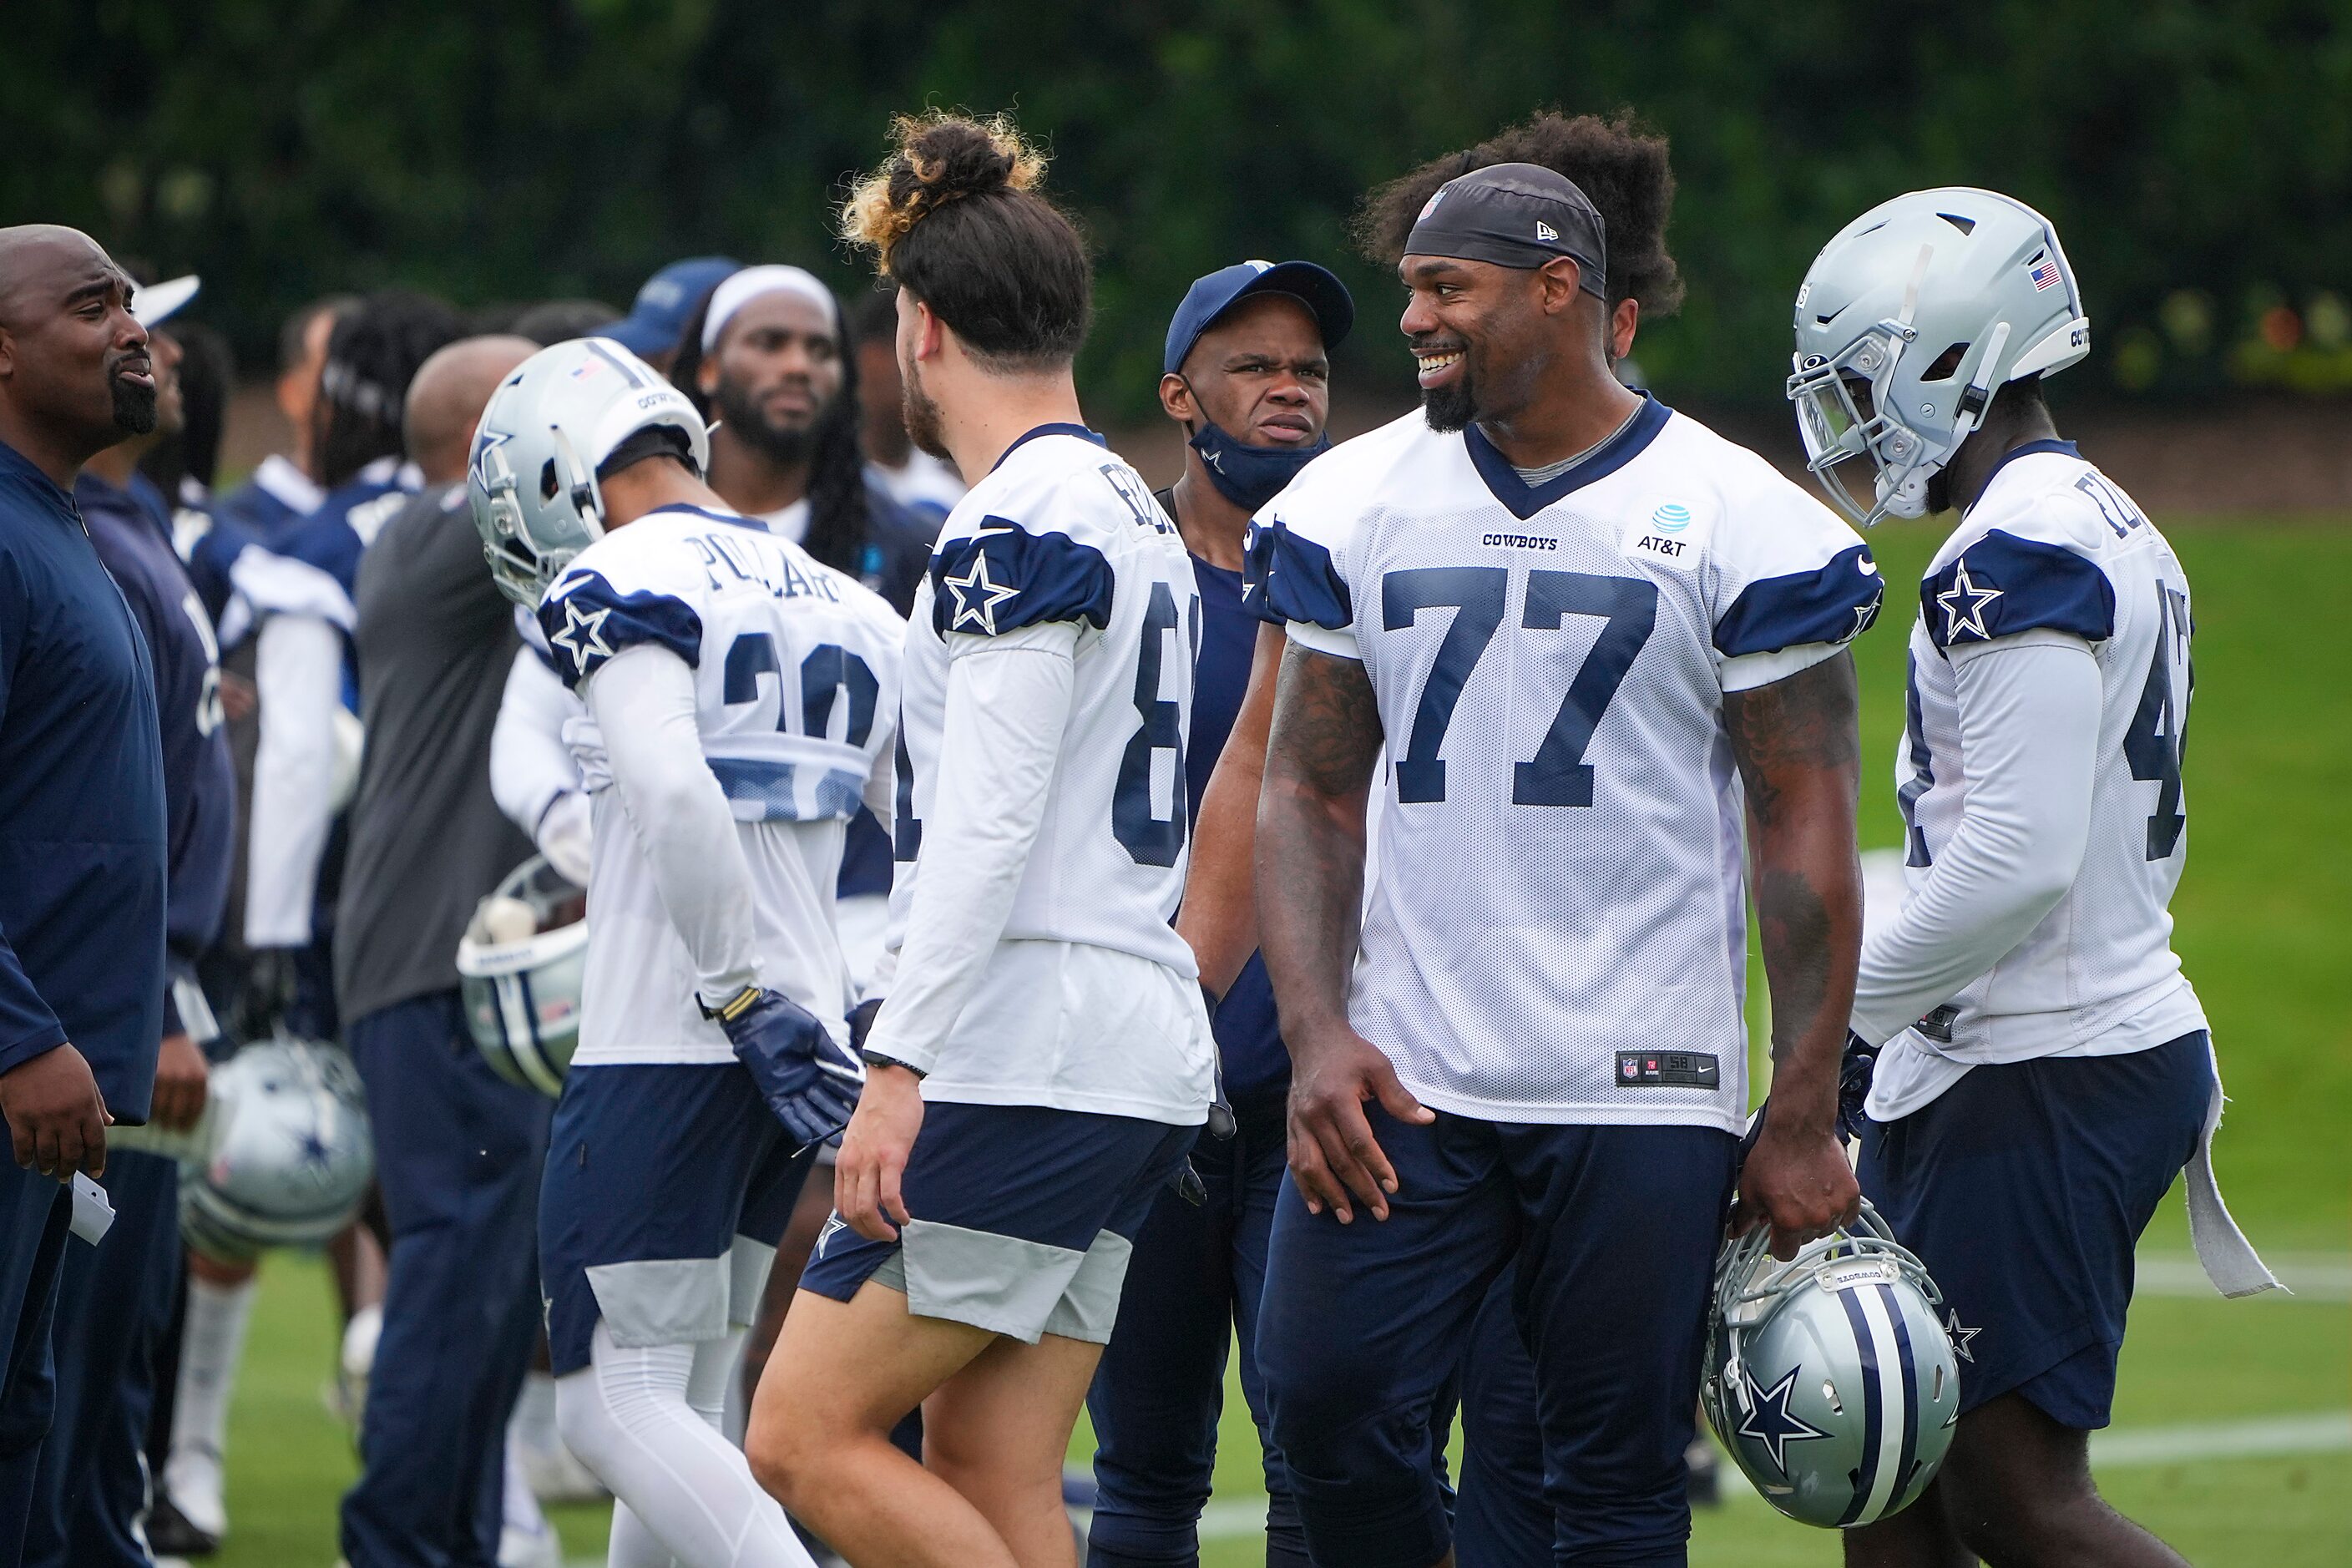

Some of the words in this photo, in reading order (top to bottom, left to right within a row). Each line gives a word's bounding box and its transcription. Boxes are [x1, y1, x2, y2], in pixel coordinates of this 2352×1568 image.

[1483, 534, 1558, 550] COWBOYS
[1637, 535, 1687, 557] AT&T
[1382, 567, 1658, 807] 77
